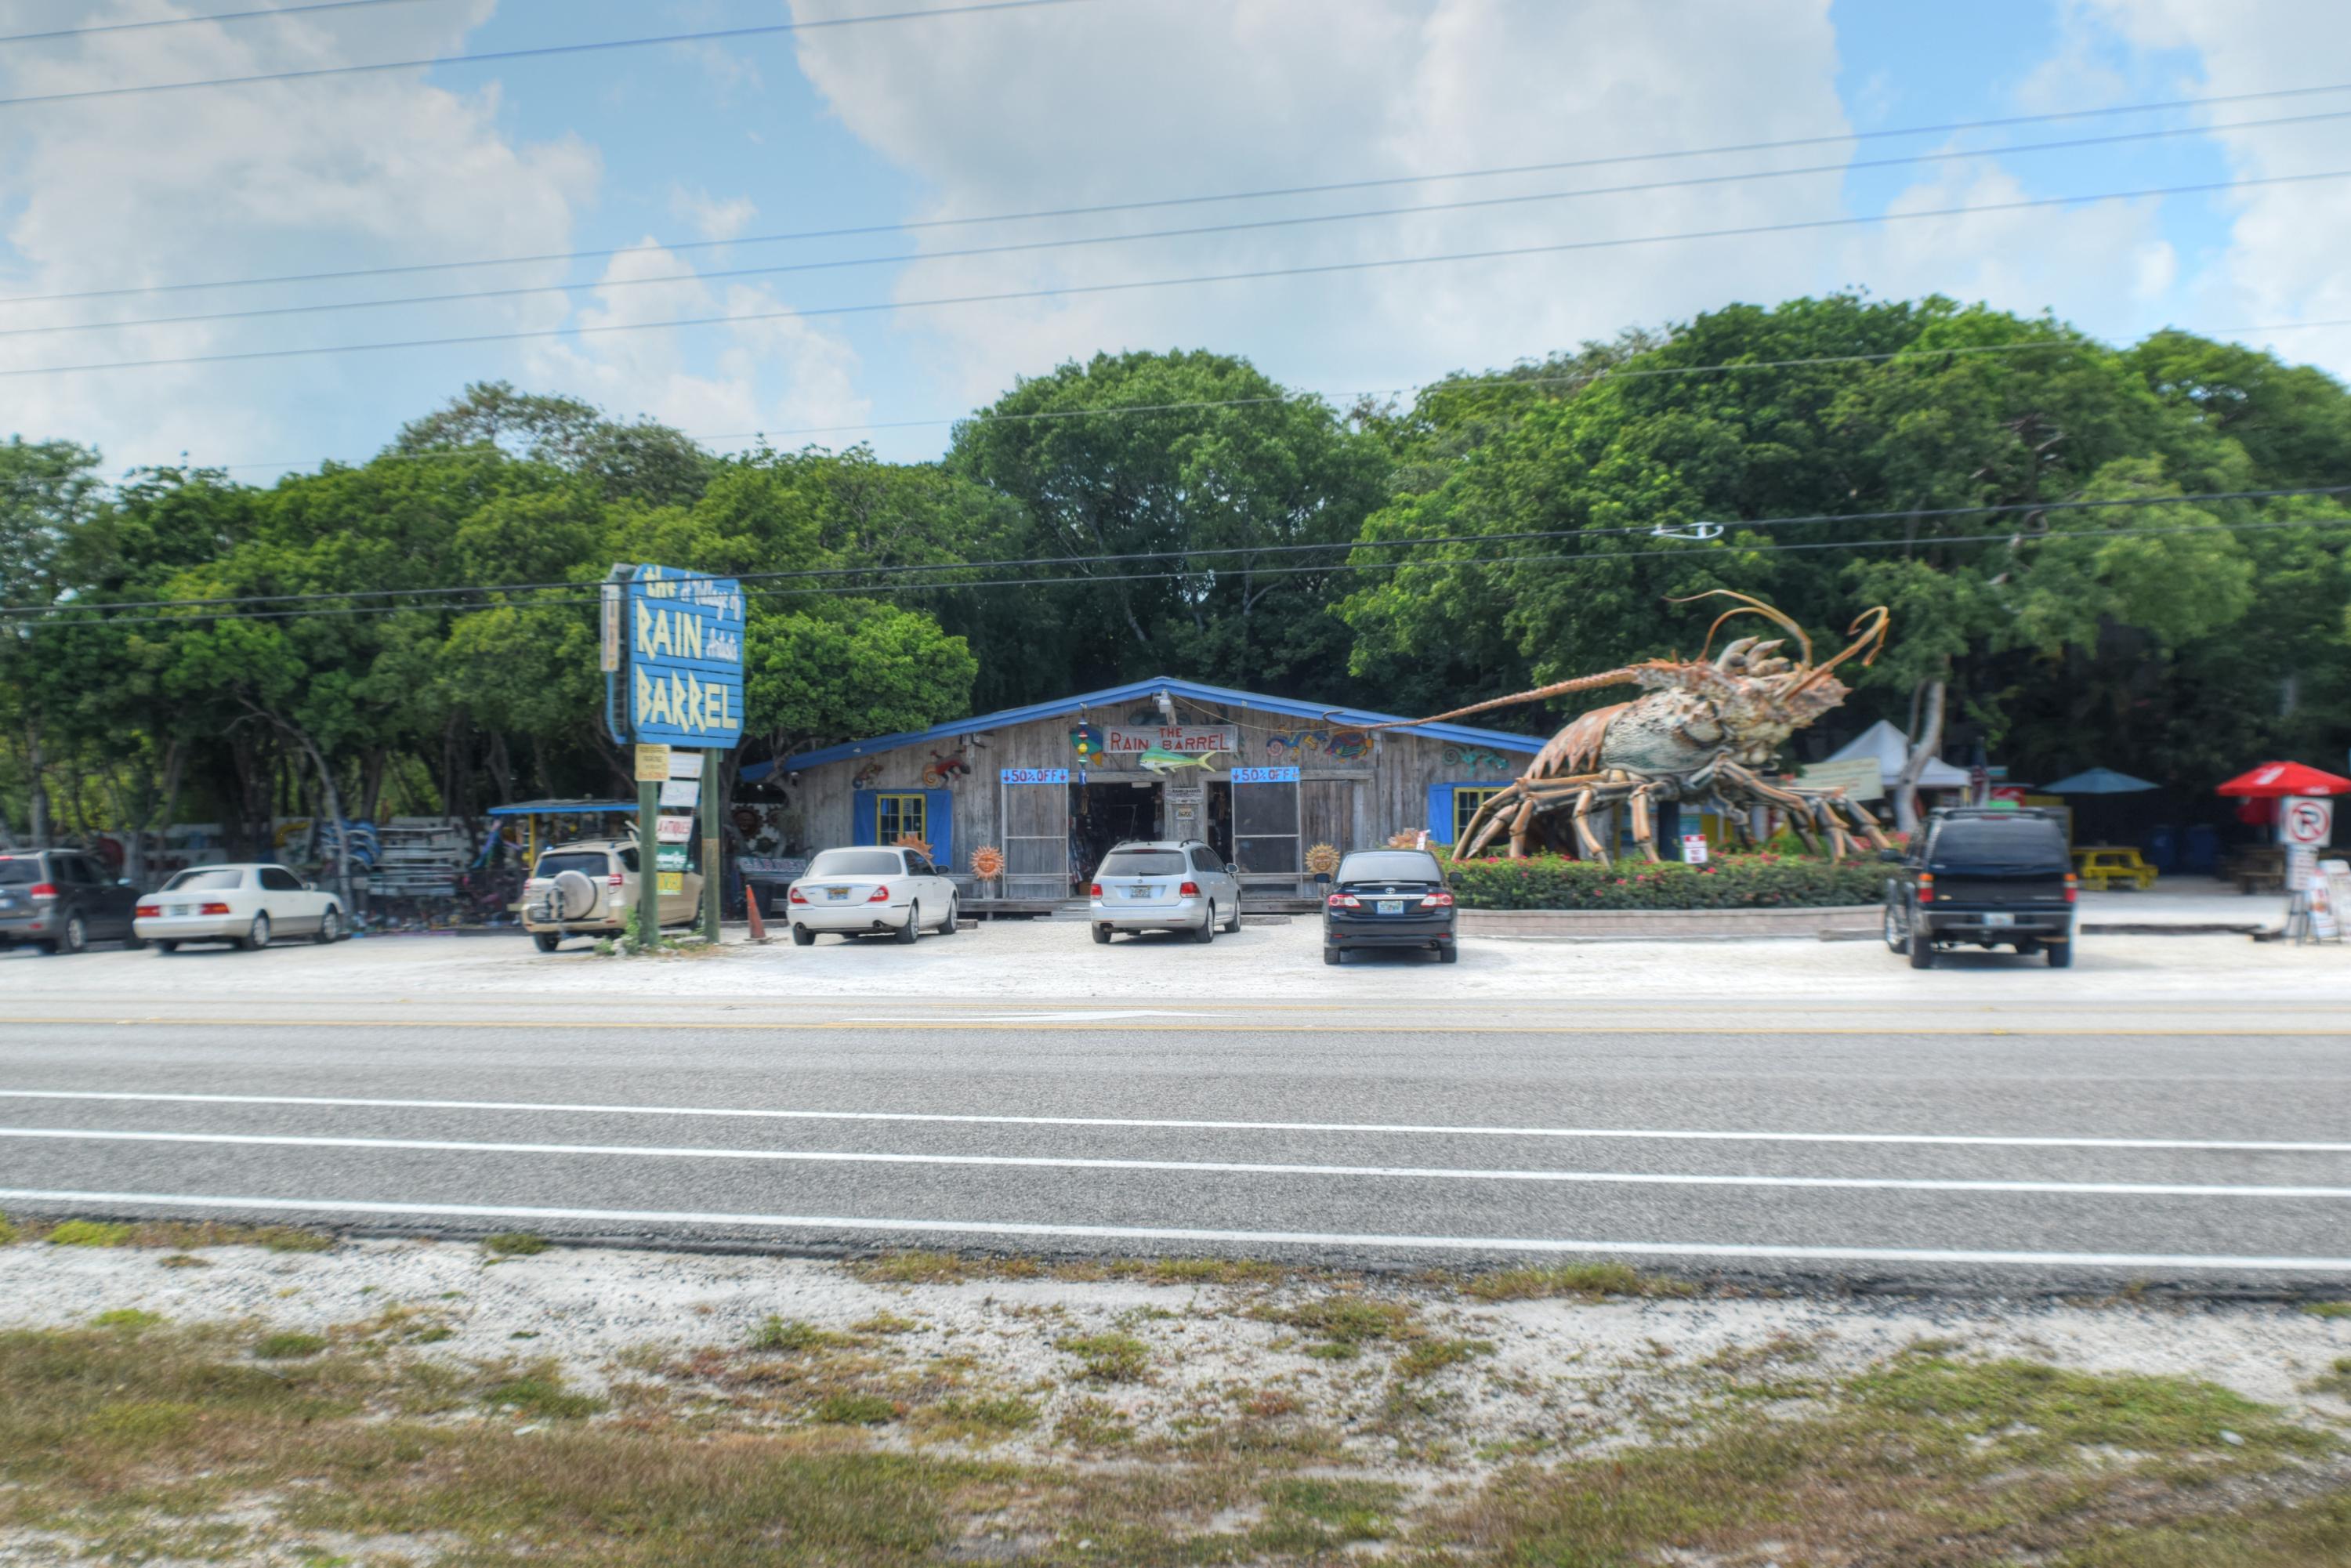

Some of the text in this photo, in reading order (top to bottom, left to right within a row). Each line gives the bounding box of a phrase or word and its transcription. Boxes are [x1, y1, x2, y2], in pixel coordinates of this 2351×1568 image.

[644, 564, 676, 598] the
[636, 596, 701, 661] RAIN
[636, 664, 737, 733] BARREL
[1110, 732, 1230, 751] RAIN BARREL
[1159, 727, 1183, 738] THE
[1011, 770, 1057, 782] 50% OFF
[1242, 768, 1290, 781] 50% OFF
